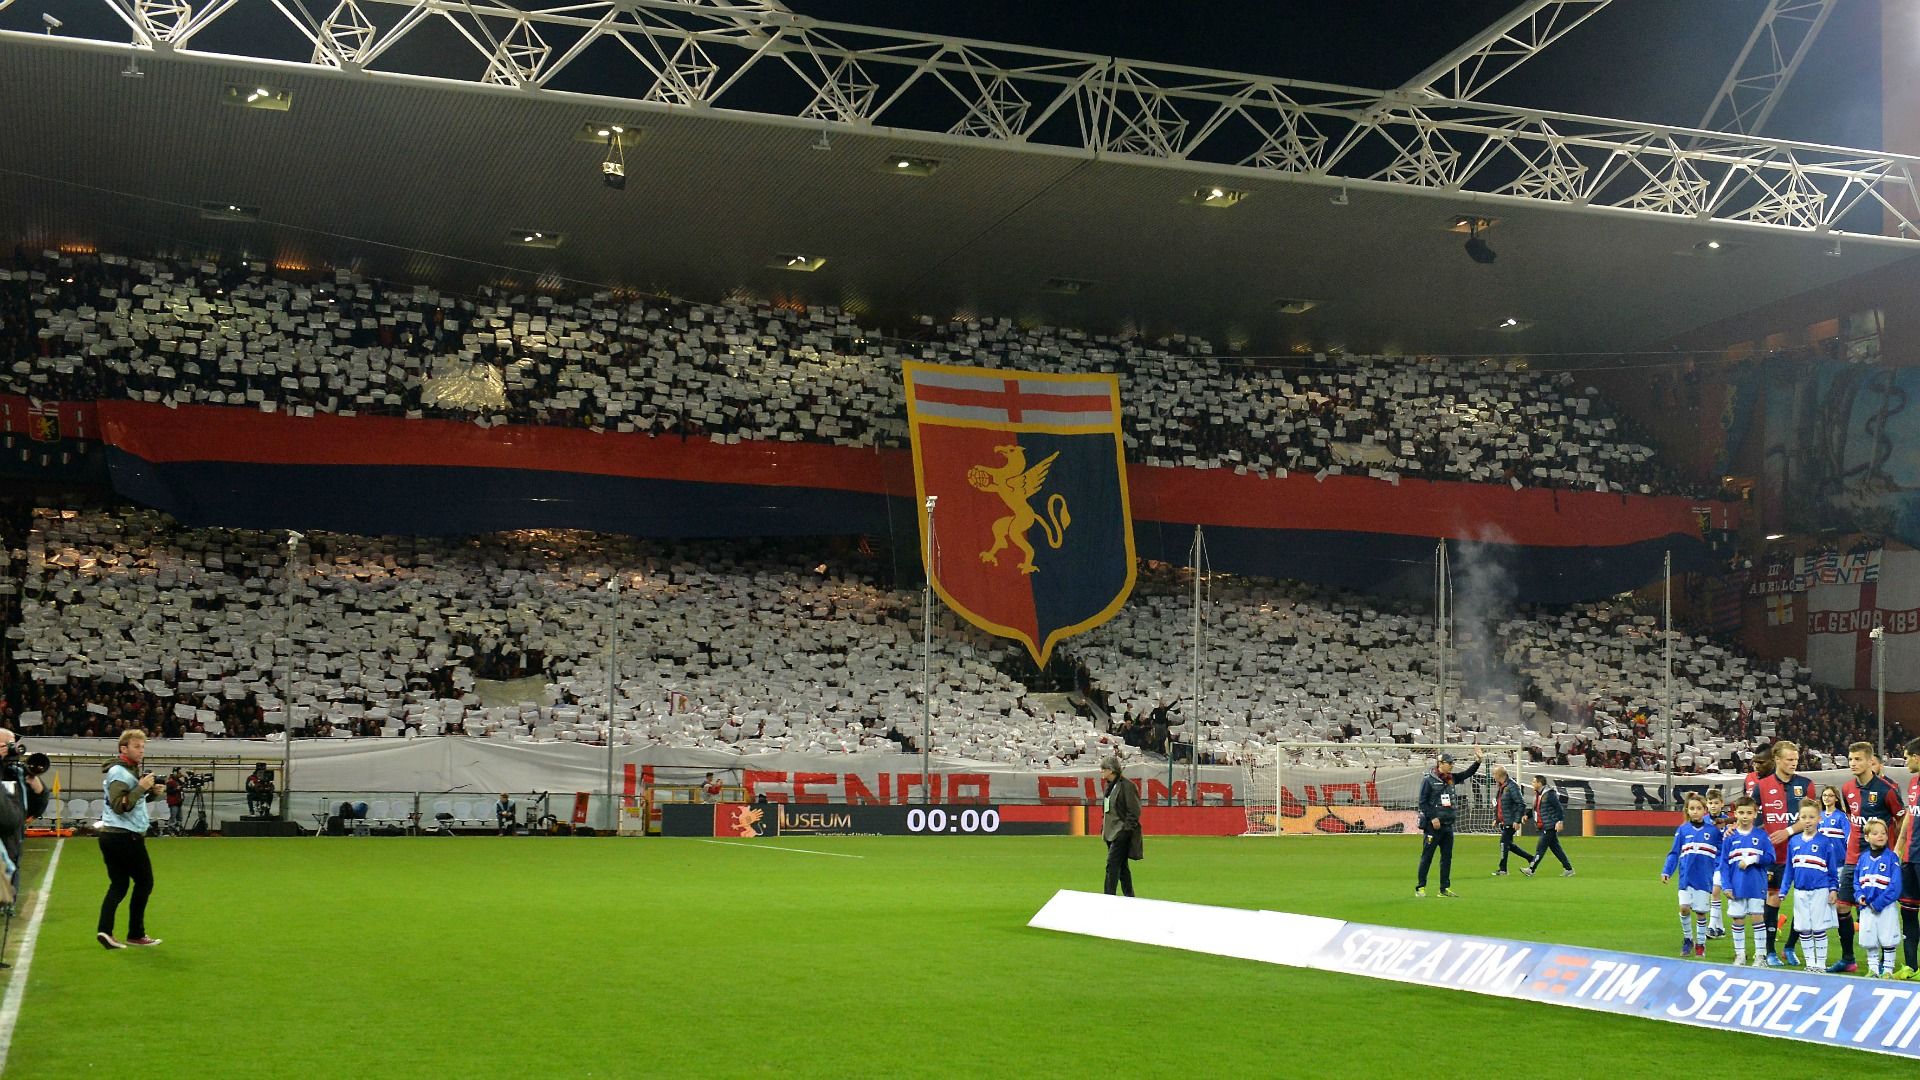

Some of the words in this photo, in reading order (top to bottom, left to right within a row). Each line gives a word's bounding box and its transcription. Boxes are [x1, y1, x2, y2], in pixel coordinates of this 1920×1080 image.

[1828, 610, 1883, 633] GENOA
[907, 808, 999, 833] 00:00
[1766, 812, 1800, 822] EVIV
[1342, 928, 1431, 976] SERIE
[1412, 939, 1451, 981] A
[1447, 941, 1531, 992] TIM
[1574, 960, 1661, 1004] TIM
[1666, 969, 1820, 1032] SERIE
[1794, 984, 1854, 1038] A
